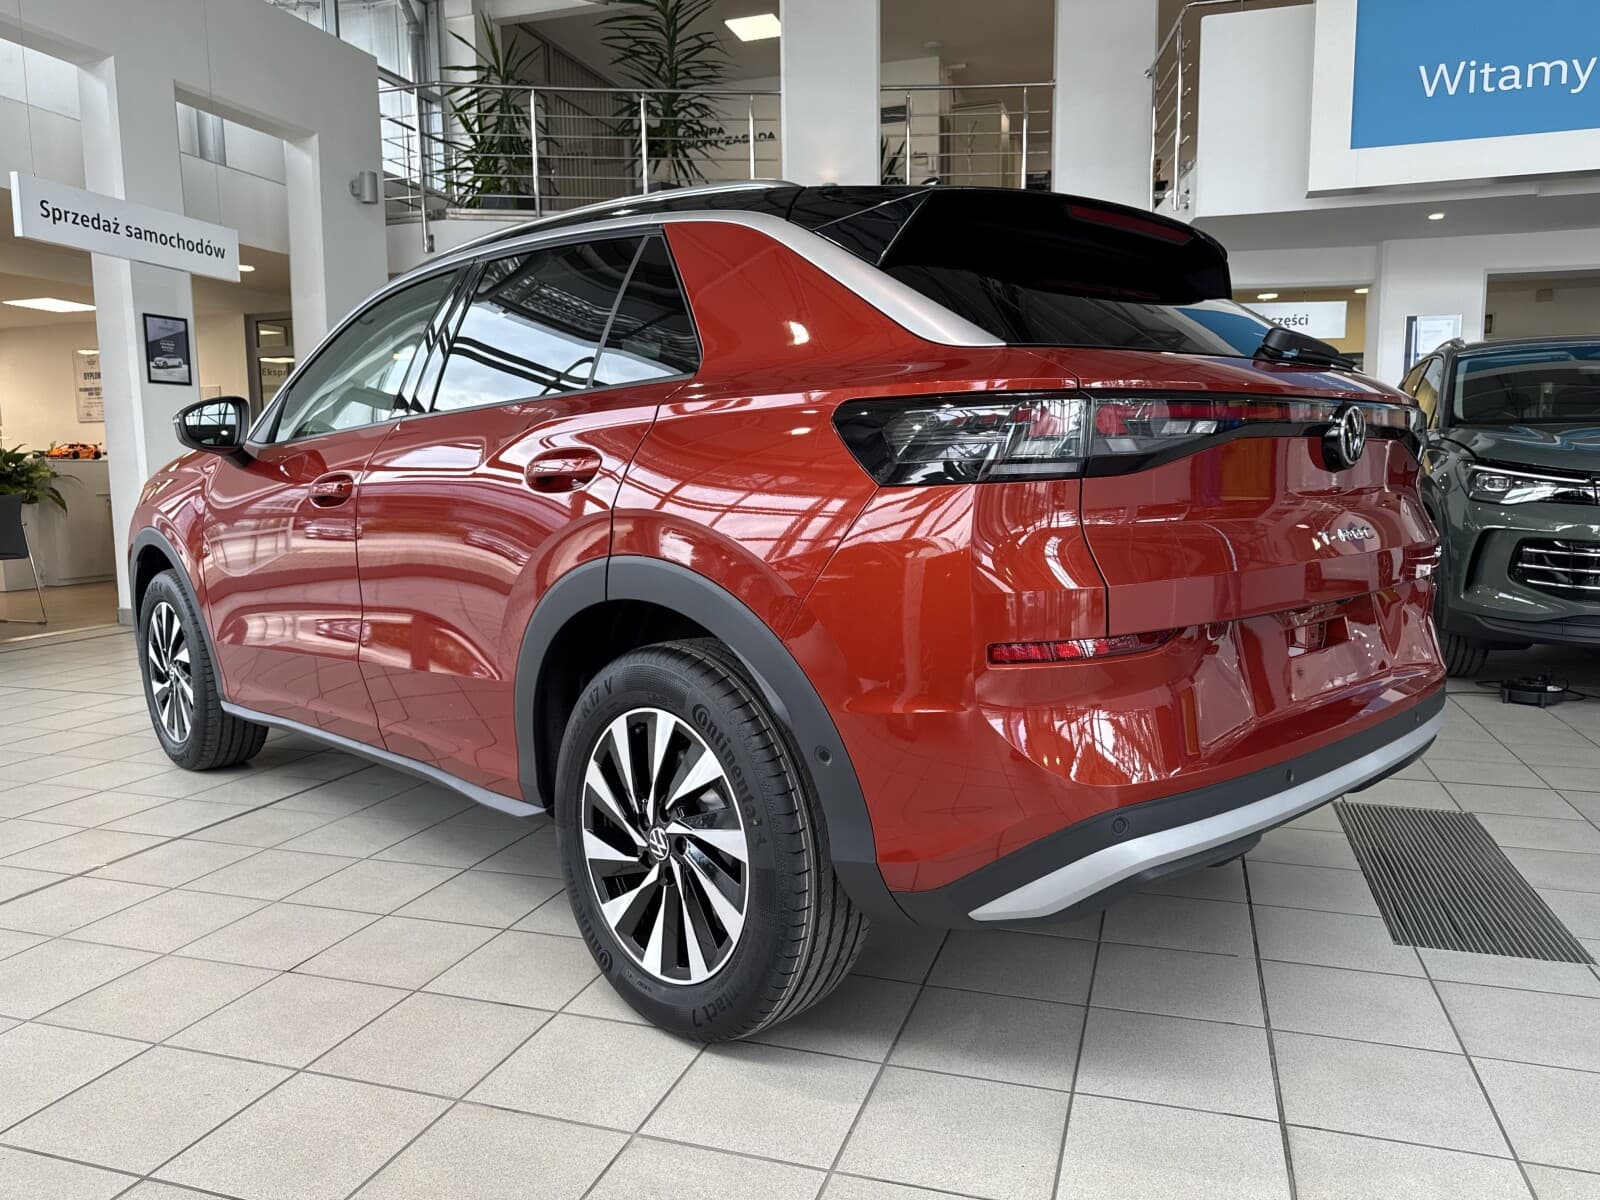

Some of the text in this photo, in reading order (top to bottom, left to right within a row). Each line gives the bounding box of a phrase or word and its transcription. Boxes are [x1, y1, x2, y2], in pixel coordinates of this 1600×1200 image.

[1418, 56, 1598, 98] Witamy
[40, 199, 226, 259] Sprzedaż samochodów
[262, 367, 287, 378] Ekspr
